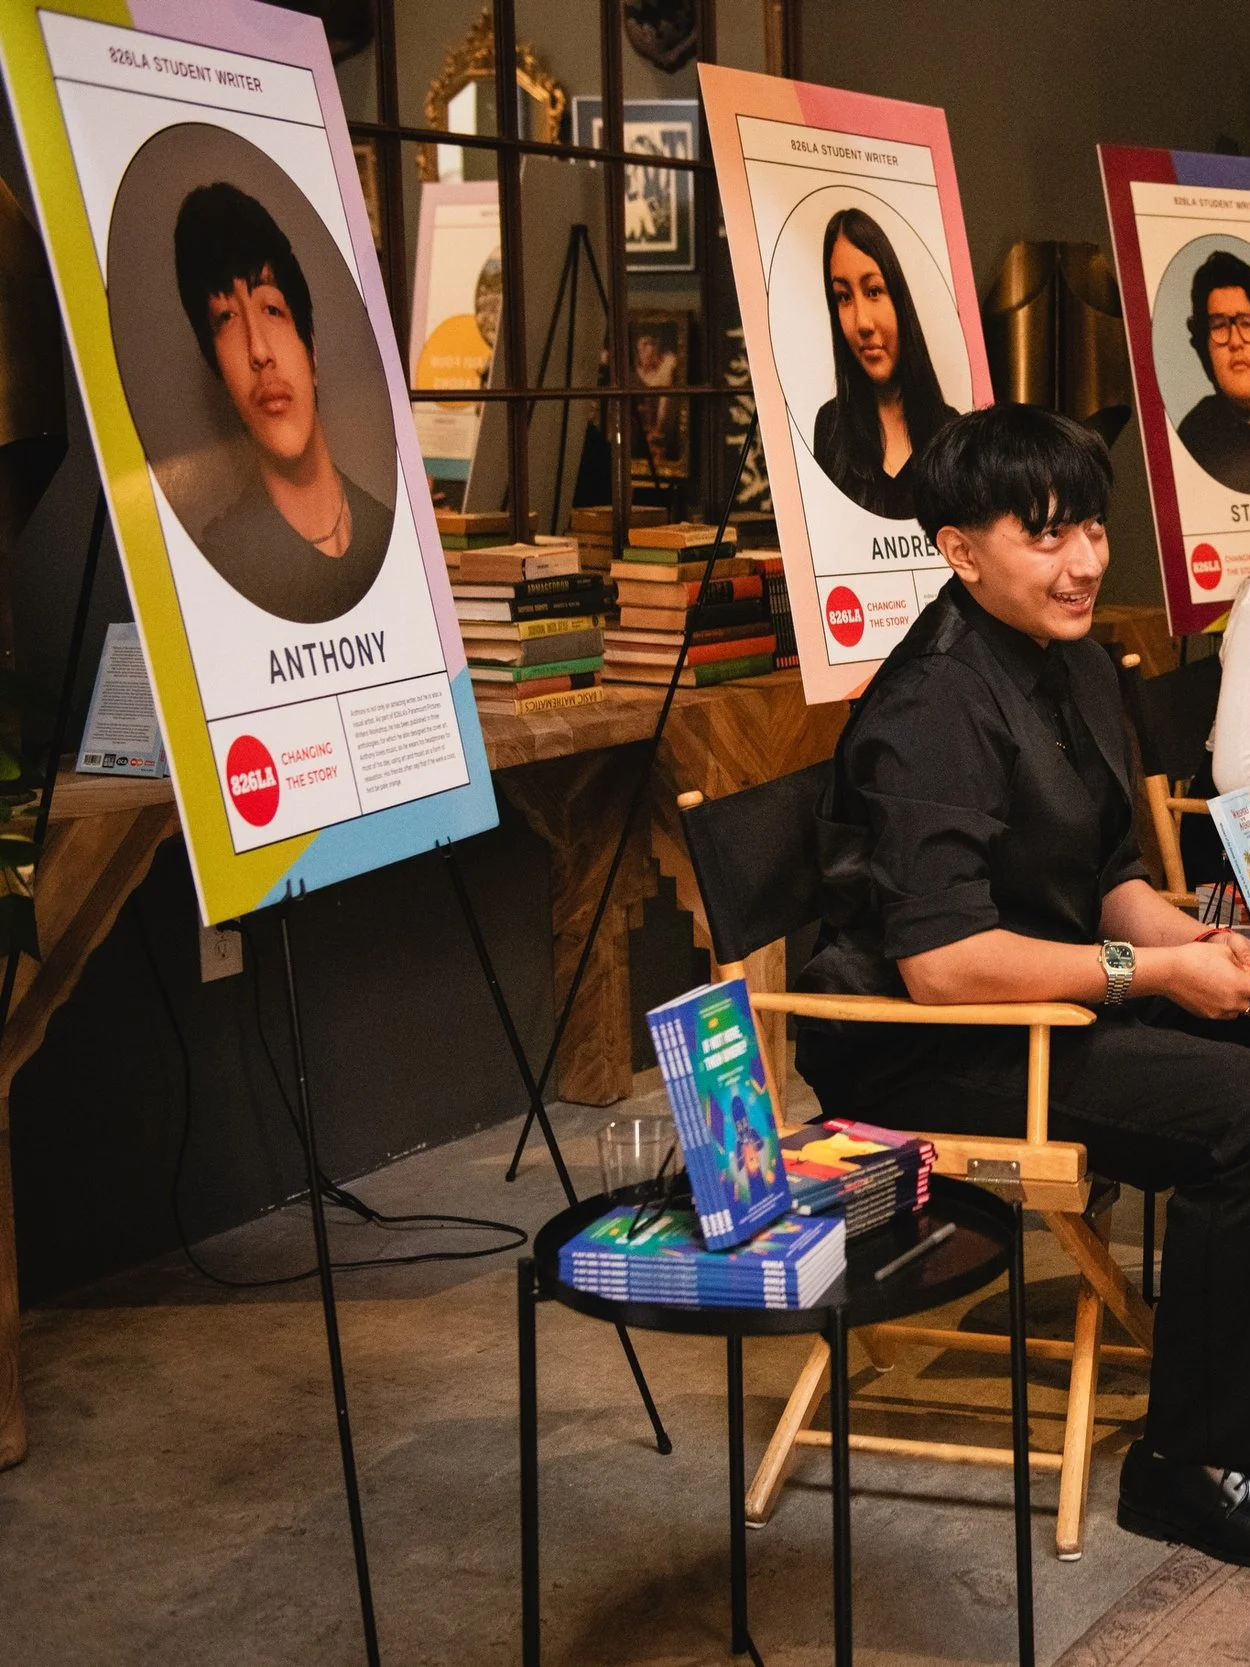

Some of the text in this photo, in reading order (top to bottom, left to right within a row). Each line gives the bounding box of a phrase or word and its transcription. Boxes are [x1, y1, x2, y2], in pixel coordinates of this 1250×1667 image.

[109, 46, 264, 93] 826LA STUDENT WRITER
[790, 139, 899, 166] 826LA STUDENT WRITER
[872, 534, 941, 560] ANDRE
[829, 608, 863, 625] 826LA
[867, 599, 907, 612] CHANGING
[870, 616, 909, 628] THE STORY
[269, 630, 387, 685] ANTHONY
[525, 695, 576, 712] MATHEMATICS
[281, 741, 333, 766] CHANGING
[230, 766, 278, 796] 826LA
[286, 765, 338, 790] THE STORY
